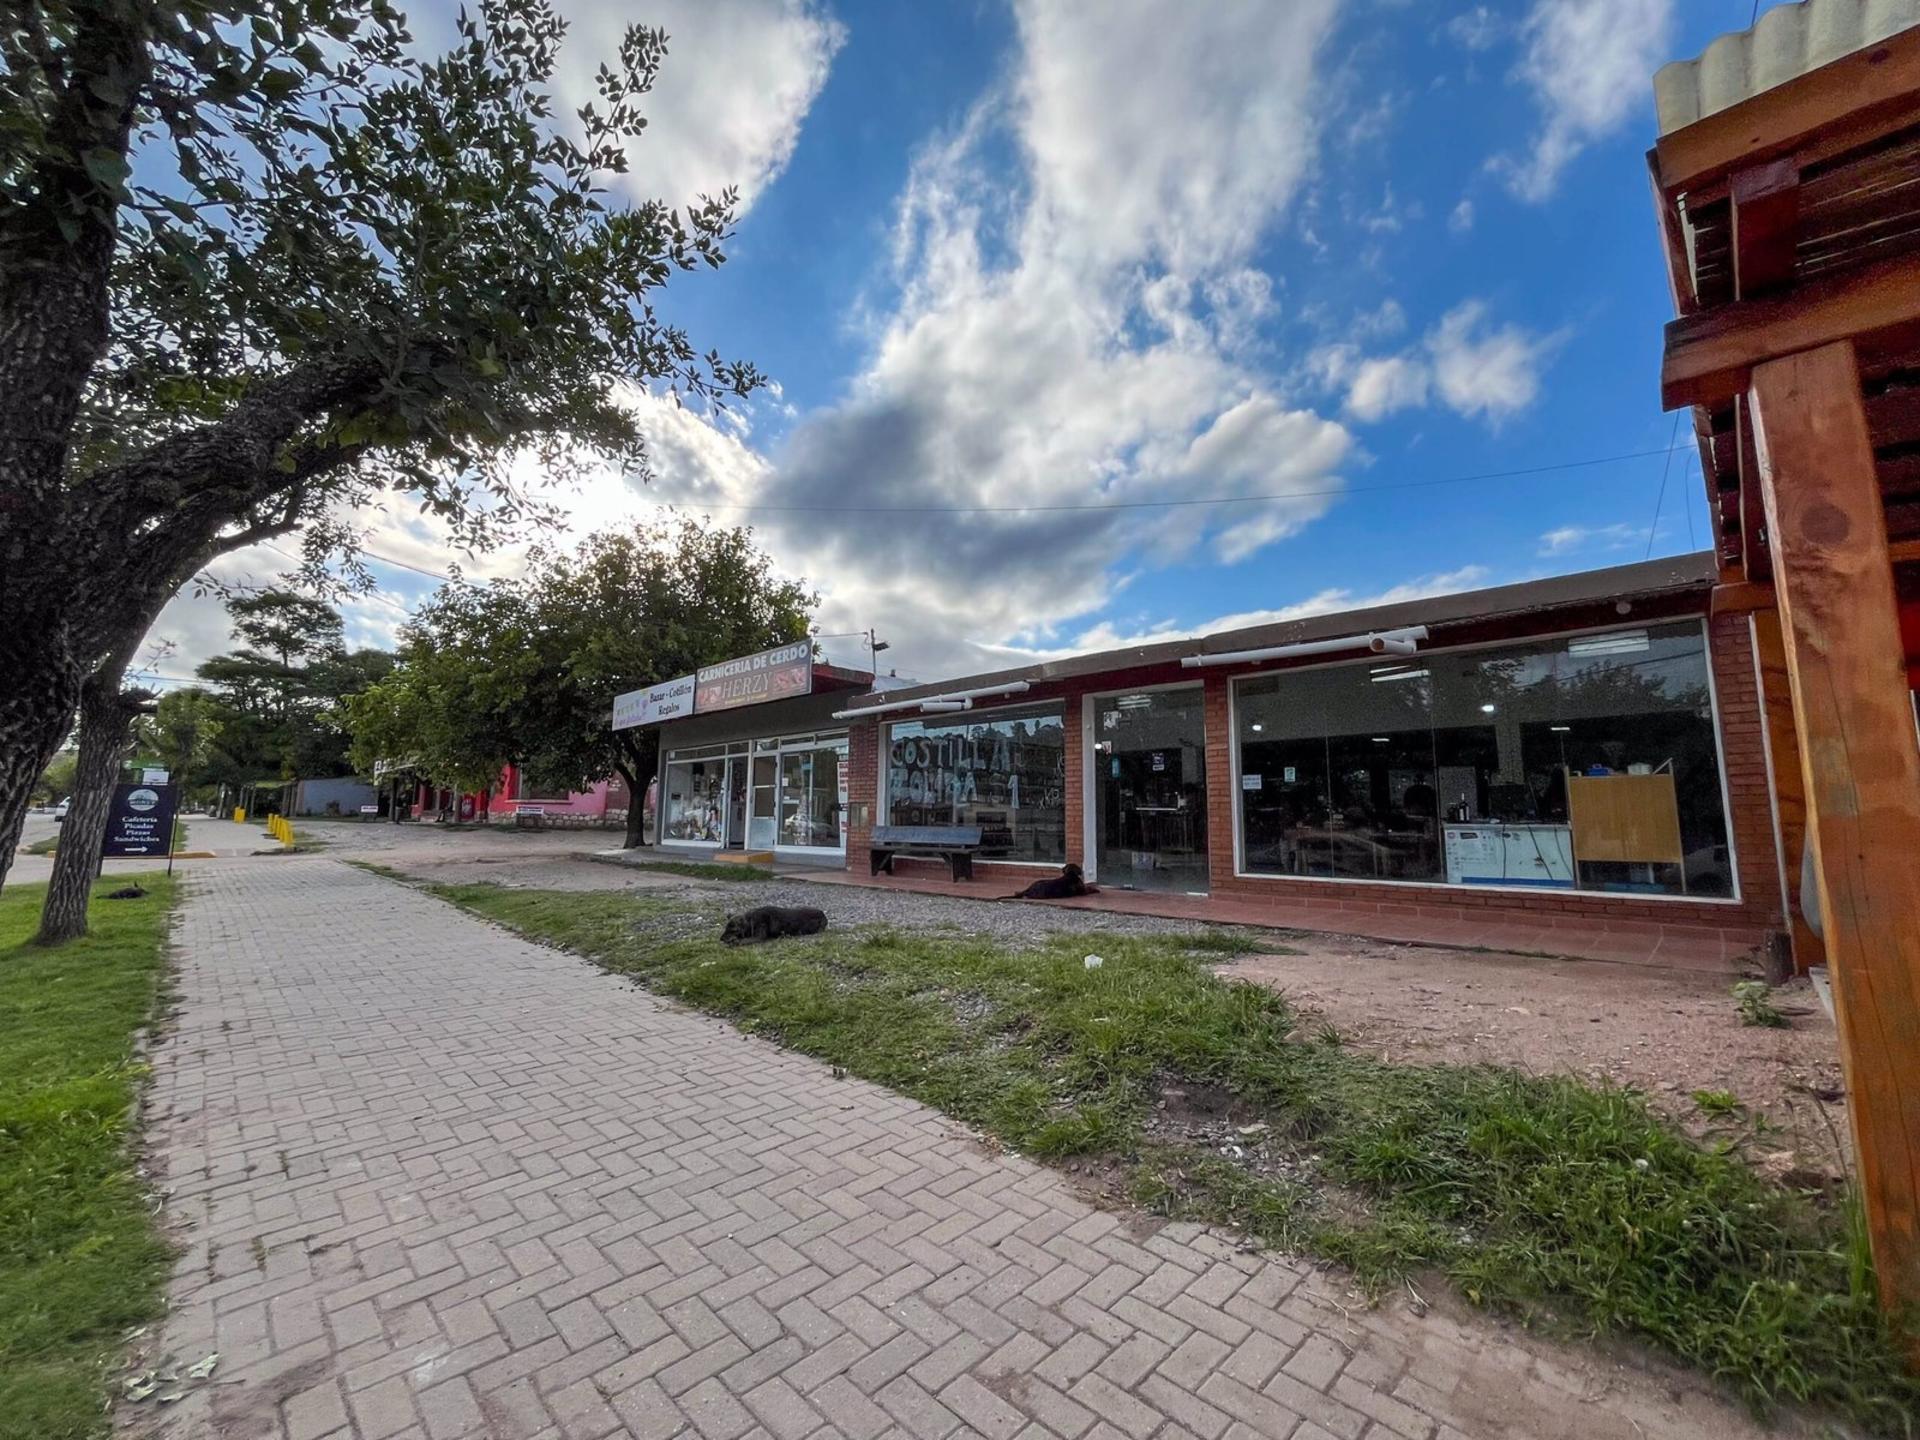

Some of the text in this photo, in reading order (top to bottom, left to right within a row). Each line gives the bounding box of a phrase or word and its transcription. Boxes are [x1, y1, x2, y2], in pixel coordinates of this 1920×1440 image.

[699, 644, 808, 682] CARNICERIA DE CERDO
[649, 692, 665, 703] Bazar
[722, 672, 774, 698] HERZY
[658, 703, 680, 716] Regalos
[889, 737, 1010, 771] COSTILLA
